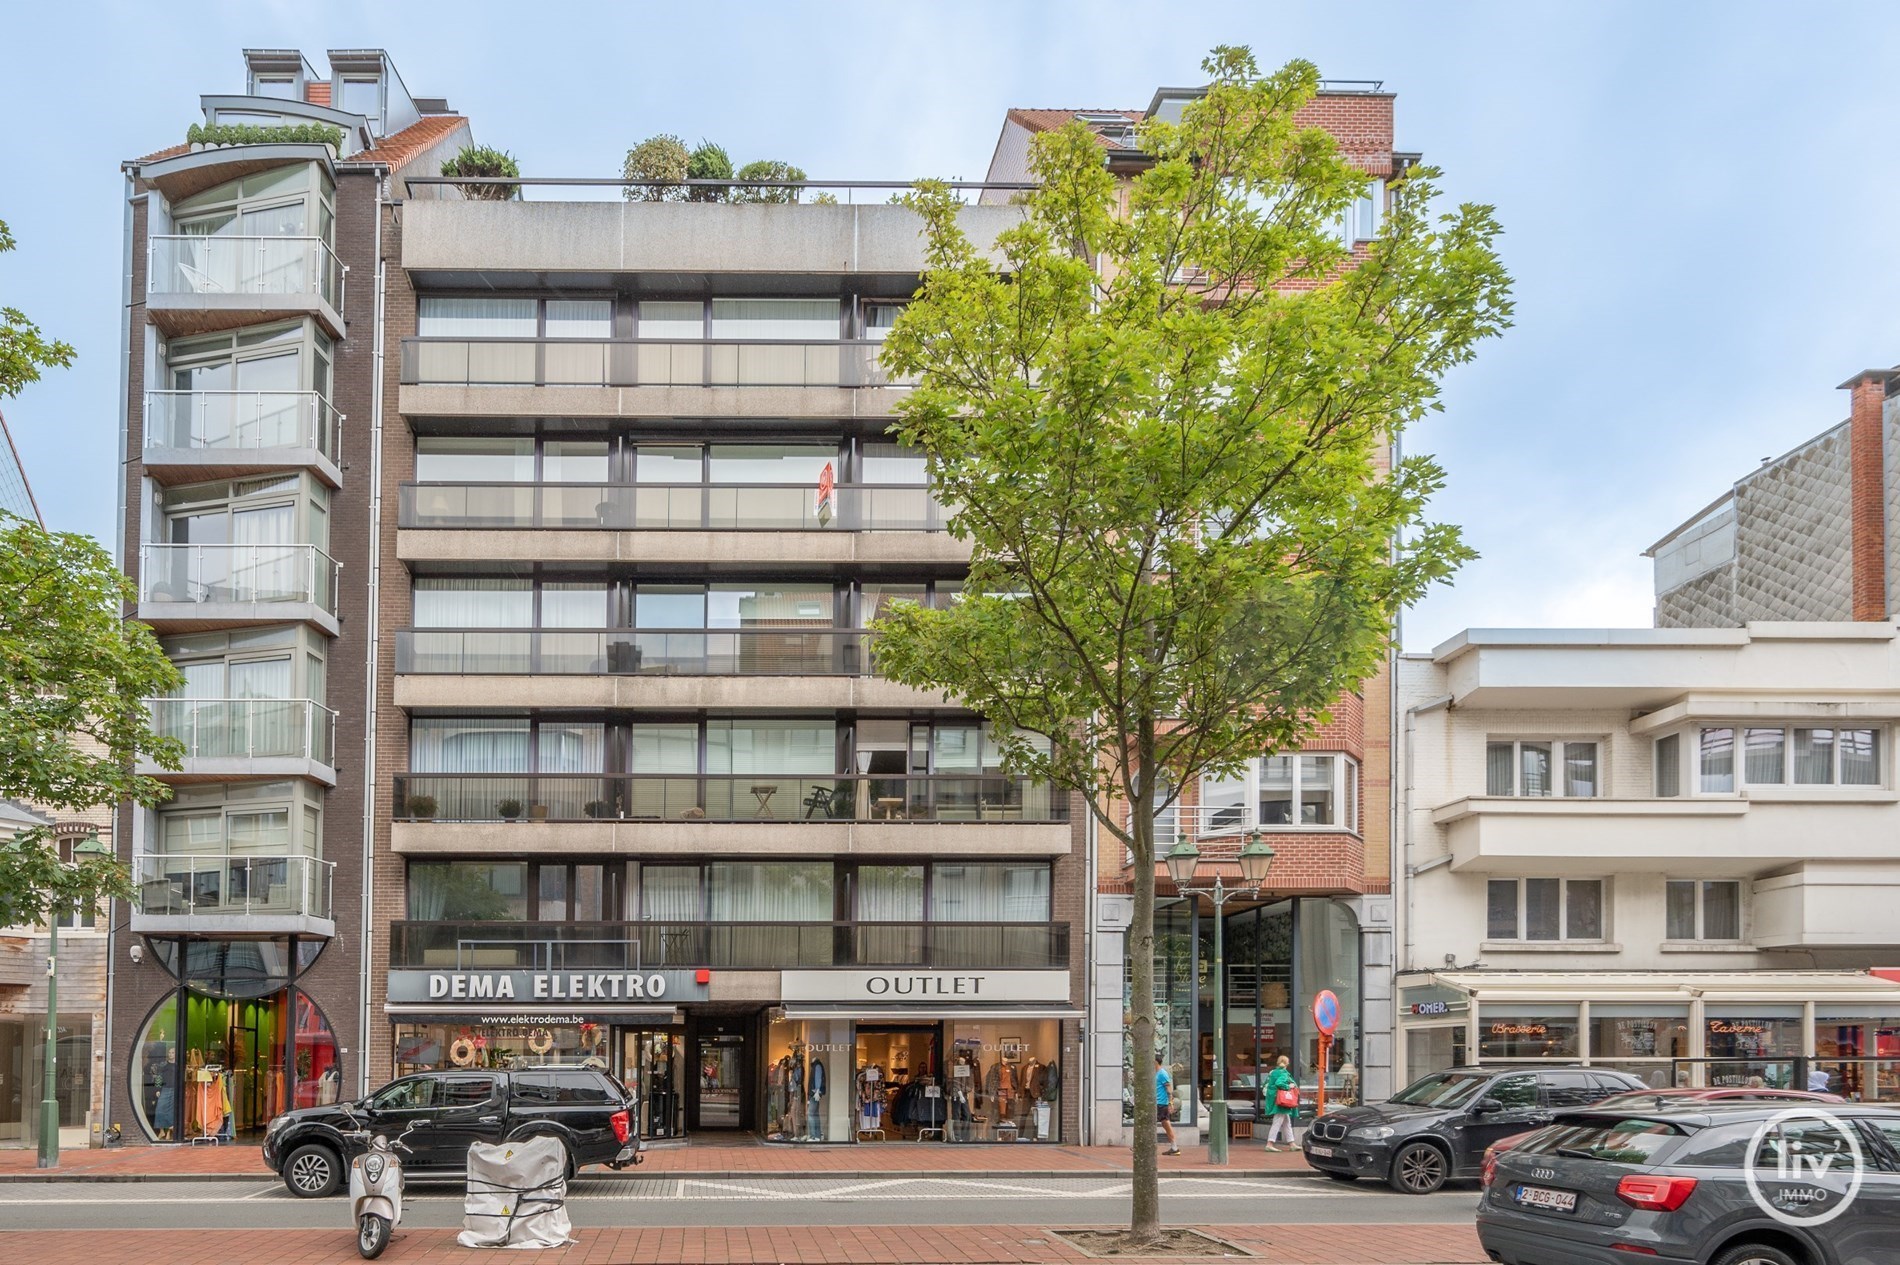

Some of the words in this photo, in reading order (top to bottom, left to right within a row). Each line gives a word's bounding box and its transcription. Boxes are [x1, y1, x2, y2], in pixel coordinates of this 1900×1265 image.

[429, 974, 515, 998] DEMA
[534, 974, 666, 998] ELEKTRO
[866, 976, 985, 995] OUTLET
[481, 1014, 584, 1024] www.elektrodema.be
[1491, 1023, 1547, 1034] Brasserie
[1709, 1020, 1763, 1033] Taverne
[805, 1043, 852, 1052] OUTLET
[983, 1043, 1030, 1052] OUTLET
[1521, 1188, 1575, 1208] 2-BCG-044
